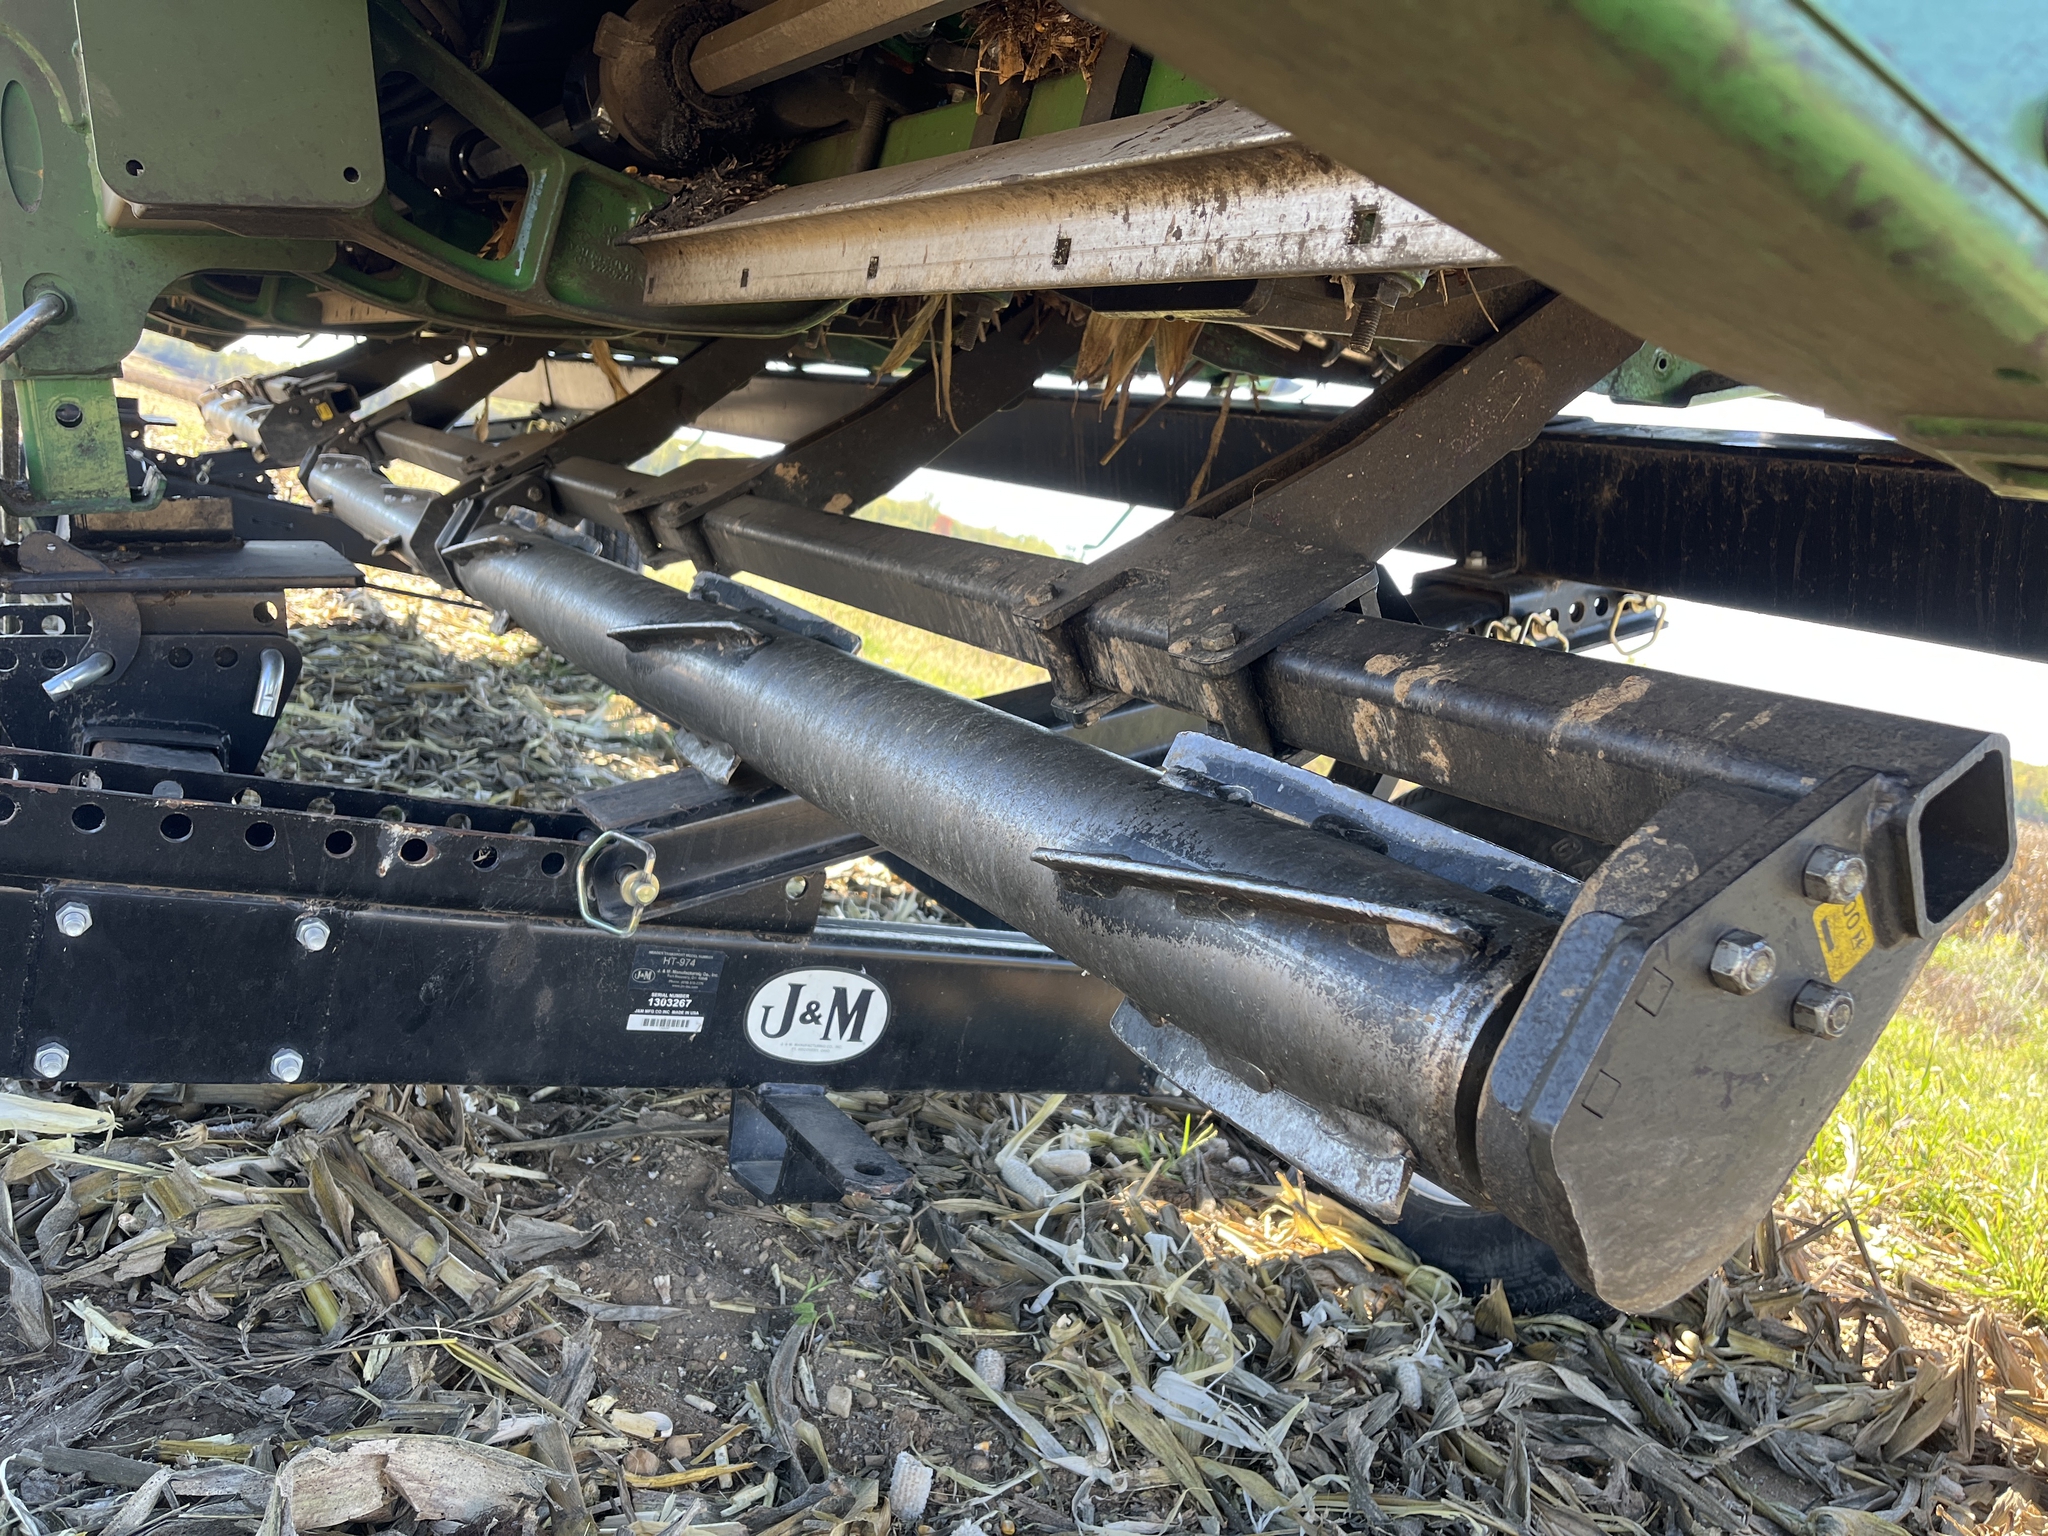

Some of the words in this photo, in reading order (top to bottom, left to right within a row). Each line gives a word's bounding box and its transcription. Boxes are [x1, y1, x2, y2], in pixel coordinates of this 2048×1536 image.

[663, 956, 696, 967] HT-974
[648, 998, 692, 1008] 1303267
[761, 983, 876, 1042] J&M
